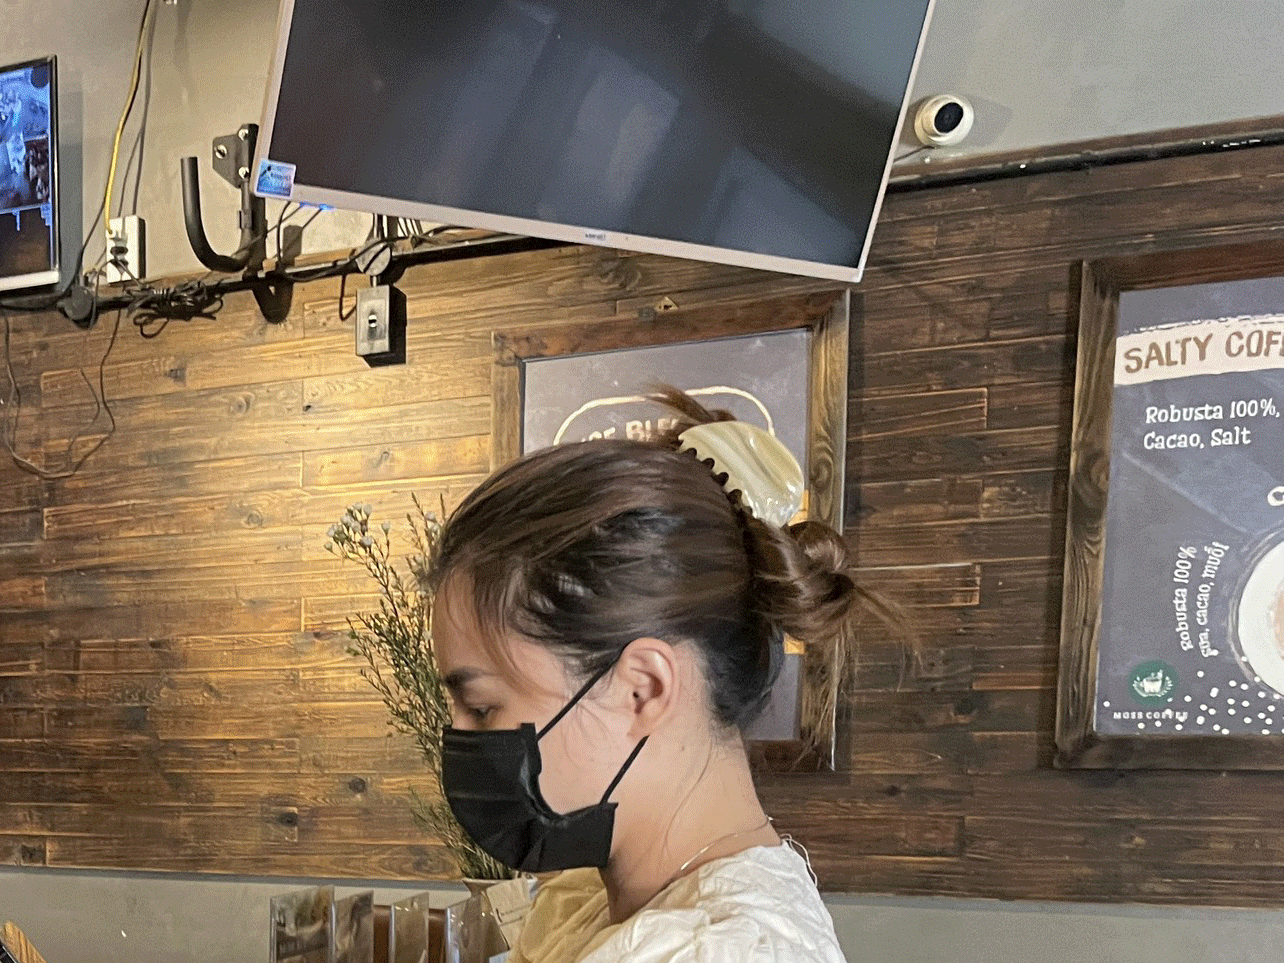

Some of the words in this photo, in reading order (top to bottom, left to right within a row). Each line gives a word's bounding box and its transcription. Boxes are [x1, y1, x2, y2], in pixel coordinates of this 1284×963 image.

[1123, 333, 1214, 373] SALTY
[1225, 329, 1284, 358] COF
[1145, 404, 1223, 424] Robusta
[1230, 397, 1281, 419] 100%,
[1143, 431, 1205, 450] Cacao,
[1210, 426, 1252, 447] Salt
[1173, 545, 1198, 584] 100%
[1172, 588, 1194, 652] Robusta
[1196, 582, 1216, 626] cacao,
[1113, 711, 1144, 720] MOSS
